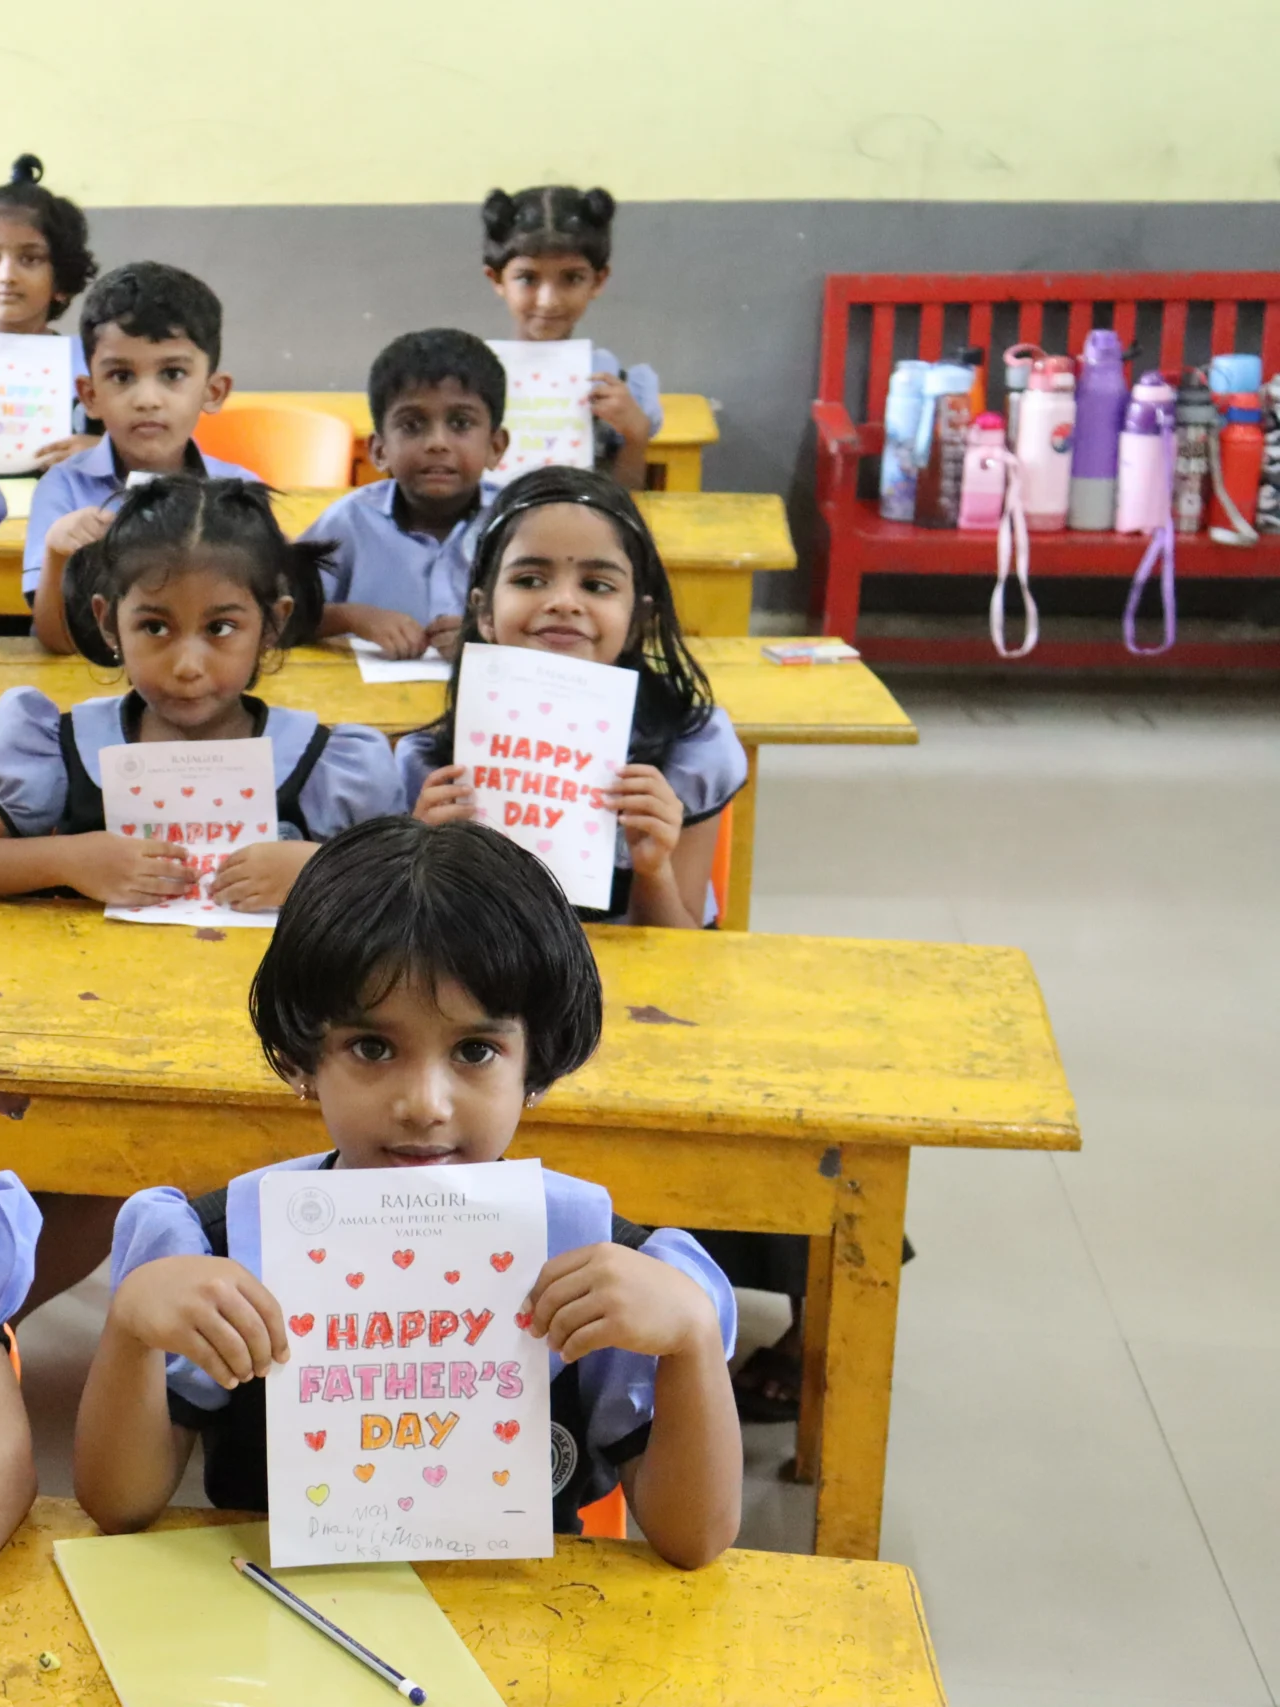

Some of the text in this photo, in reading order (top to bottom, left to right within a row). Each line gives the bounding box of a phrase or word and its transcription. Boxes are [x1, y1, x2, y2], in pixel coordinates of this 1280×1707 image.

[489, 733, 593, 771] HAPPY
[473, 765, 607, 809] FATHER'S
[503, 801, 565, 829] DAY
[143, 820, 245, 844] HAPPY
[381, 1192, 467, 1211] RAJAGIRI
[338, 1215, 377, 1225] AMALA
[380, 1215, 404, 1225] CMI
[408, 1214, 448, 1224] PUBLIC
[453, 1212, 500, 1222] SCHOOL
[395, 1228, 442, 1238] VAIKOM
[325, 1307, 495, 1351] HAPPY
[298, 1360, 524, 1404] FATHER'S
[360, 1411, 460, 1450] DAY
